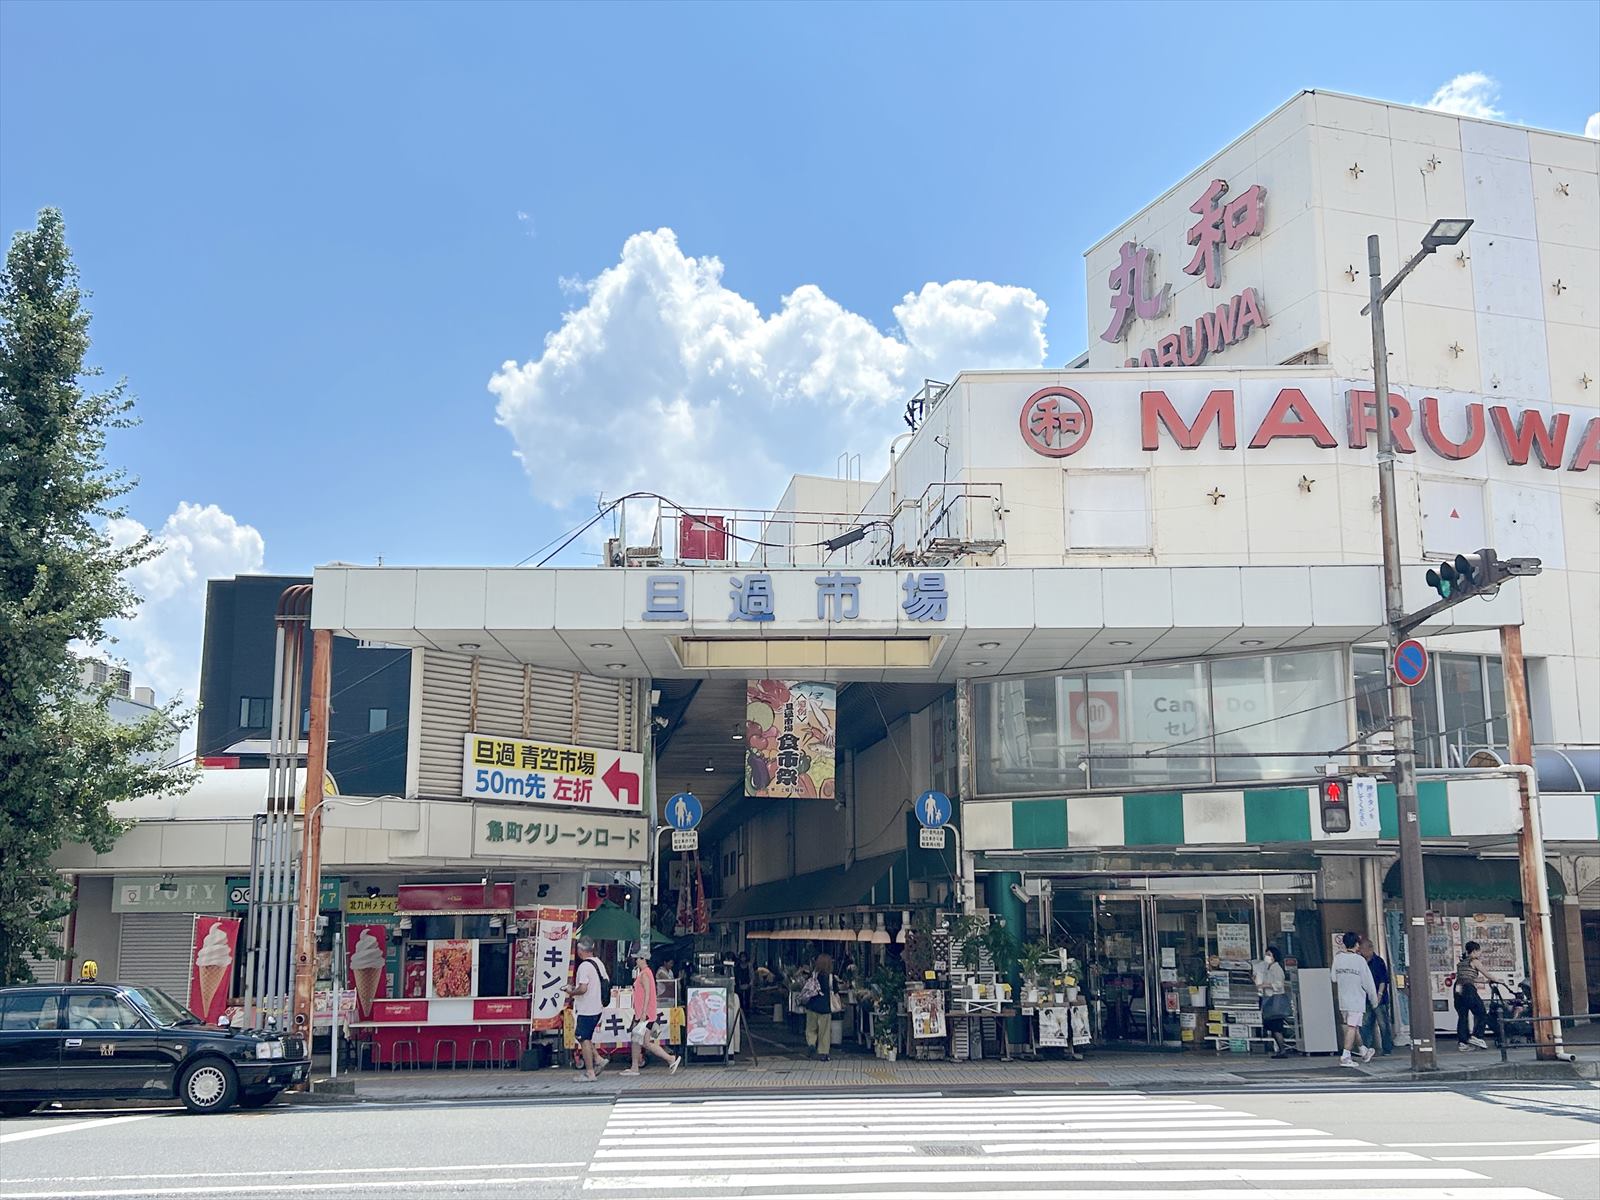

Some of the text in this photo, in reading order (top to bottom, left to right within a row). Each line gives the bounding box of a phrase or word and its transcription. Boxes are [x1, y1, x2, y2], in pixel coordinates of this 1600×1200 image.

[1100, 178, 1268, 343] 丸和
[1124, 287, 1264, 368] RUWA
[1026, 394, 1086, 450] 和
[642, 571, 949, 623] 旦過市場
[1154, 696, 1256, 712] Can Do
[474, 740, 597, 776] 旦過 青空市場
[475, 769, 593, 804] 50m先 左折
[486, 819, 641, 850] 魚町グリーンロード
[145, 884, 217, 900] TOFY
[539, 946, 563, 1011] キンパ
